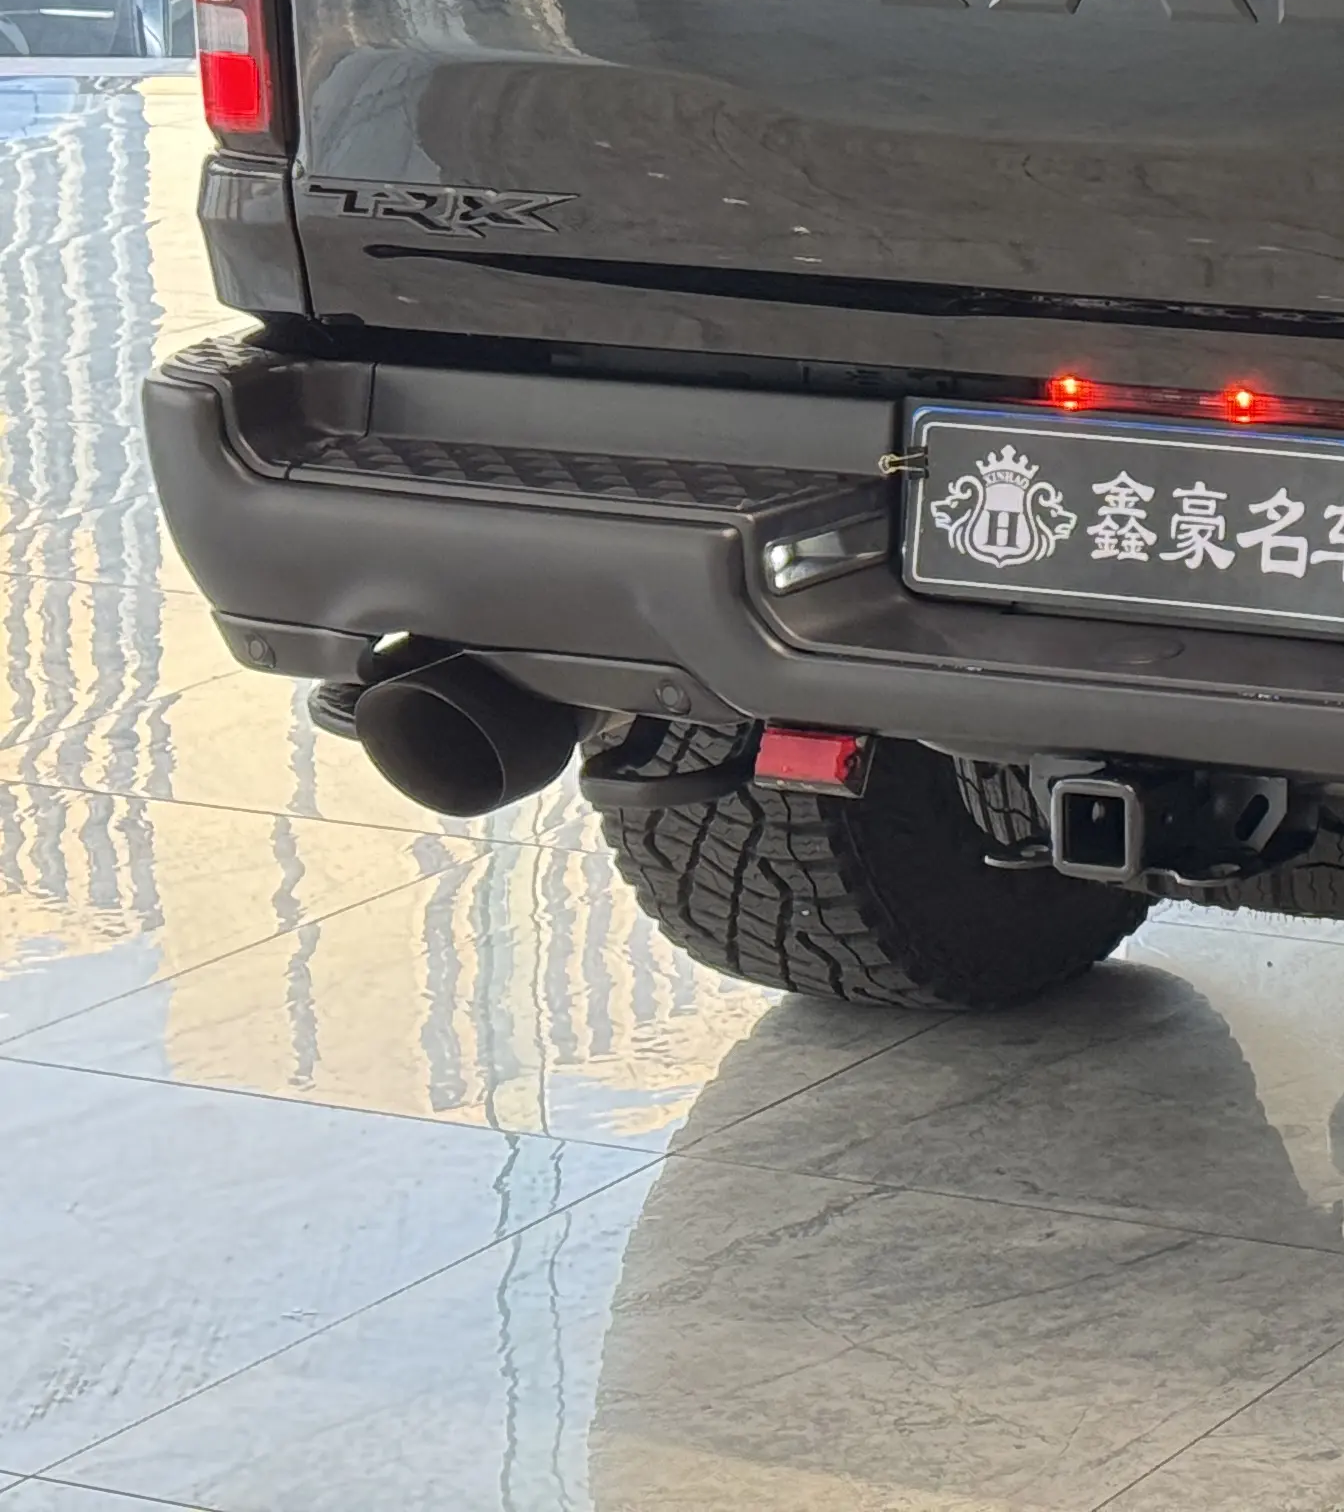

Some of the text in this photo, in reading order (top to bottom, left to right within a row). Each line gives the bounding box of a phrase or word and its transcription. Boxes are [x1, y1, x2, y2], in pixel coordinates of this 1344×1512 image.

[306, 175, 581, 238] TRX
[983, 470, 1030, 490] XINHAO
[984, 509, 1021, 549] H
